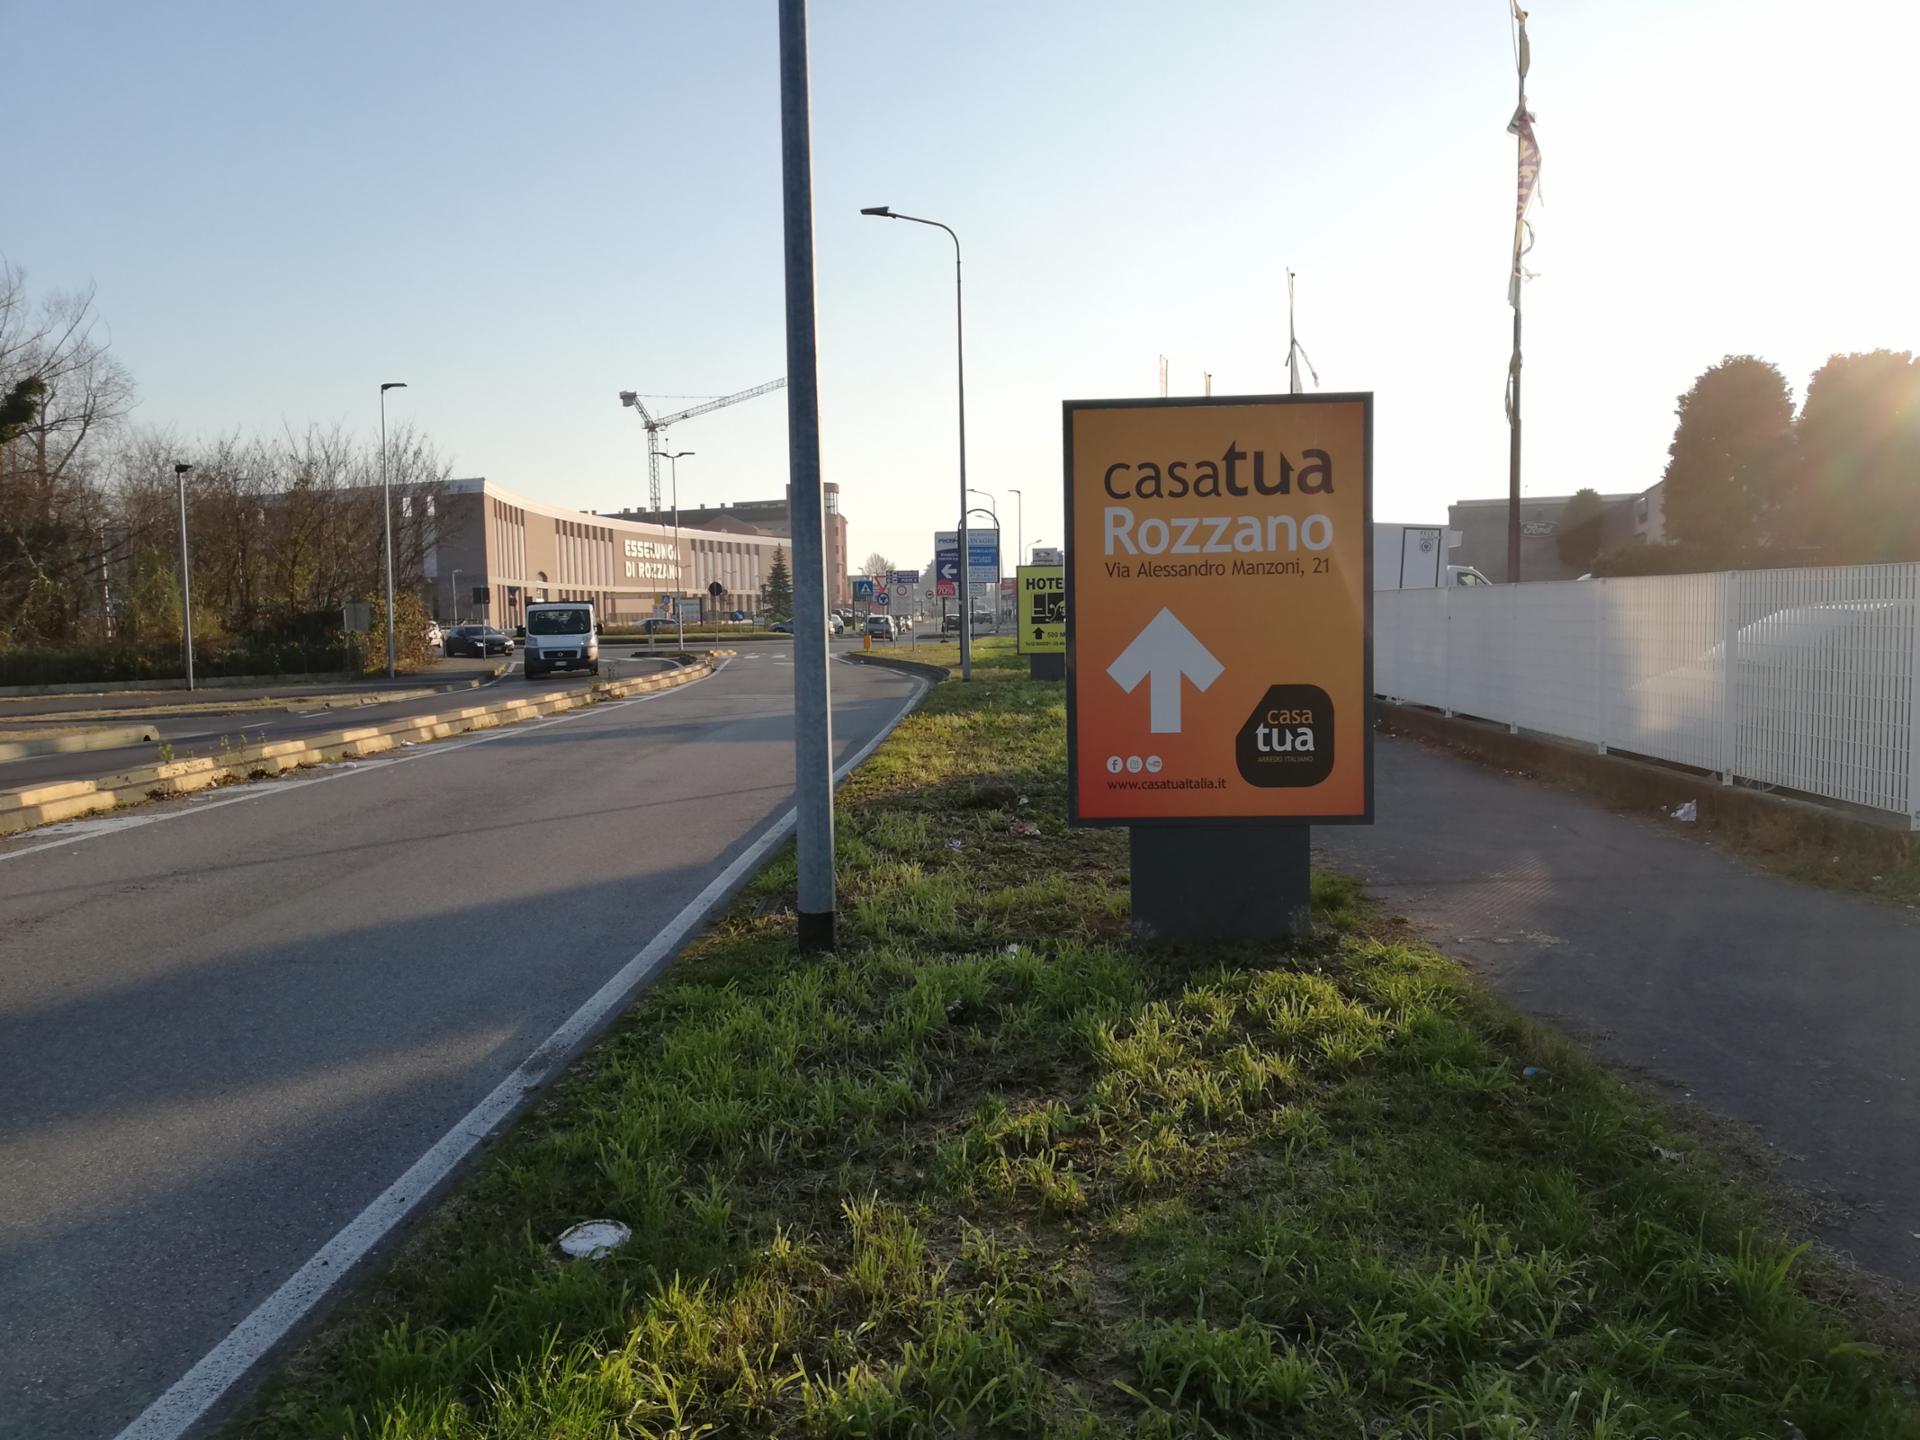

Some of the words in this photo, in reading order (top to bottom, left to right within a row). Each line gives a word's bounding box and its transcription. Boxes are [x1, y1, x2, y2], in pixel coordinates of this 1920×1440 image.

[1104, 440, 1335, 500] casatua
[1104, 505, 1335, 556] Rozzano
[624, 539, 681, 561] ESSELUNGA
[625, 560, 636, 579] DI
[1105, 561, 1131, 579] Via
[1137, 560, 1226, 578] Alessandro
[1232, 557, 1305, 577] Manzoni,
[1312, 557, 1330, 574] 21
[1026, 577, 1064, 590] HOTE
[1267, 708, 1313, 725] casa
[1255, 722, 1316, 752] tua
